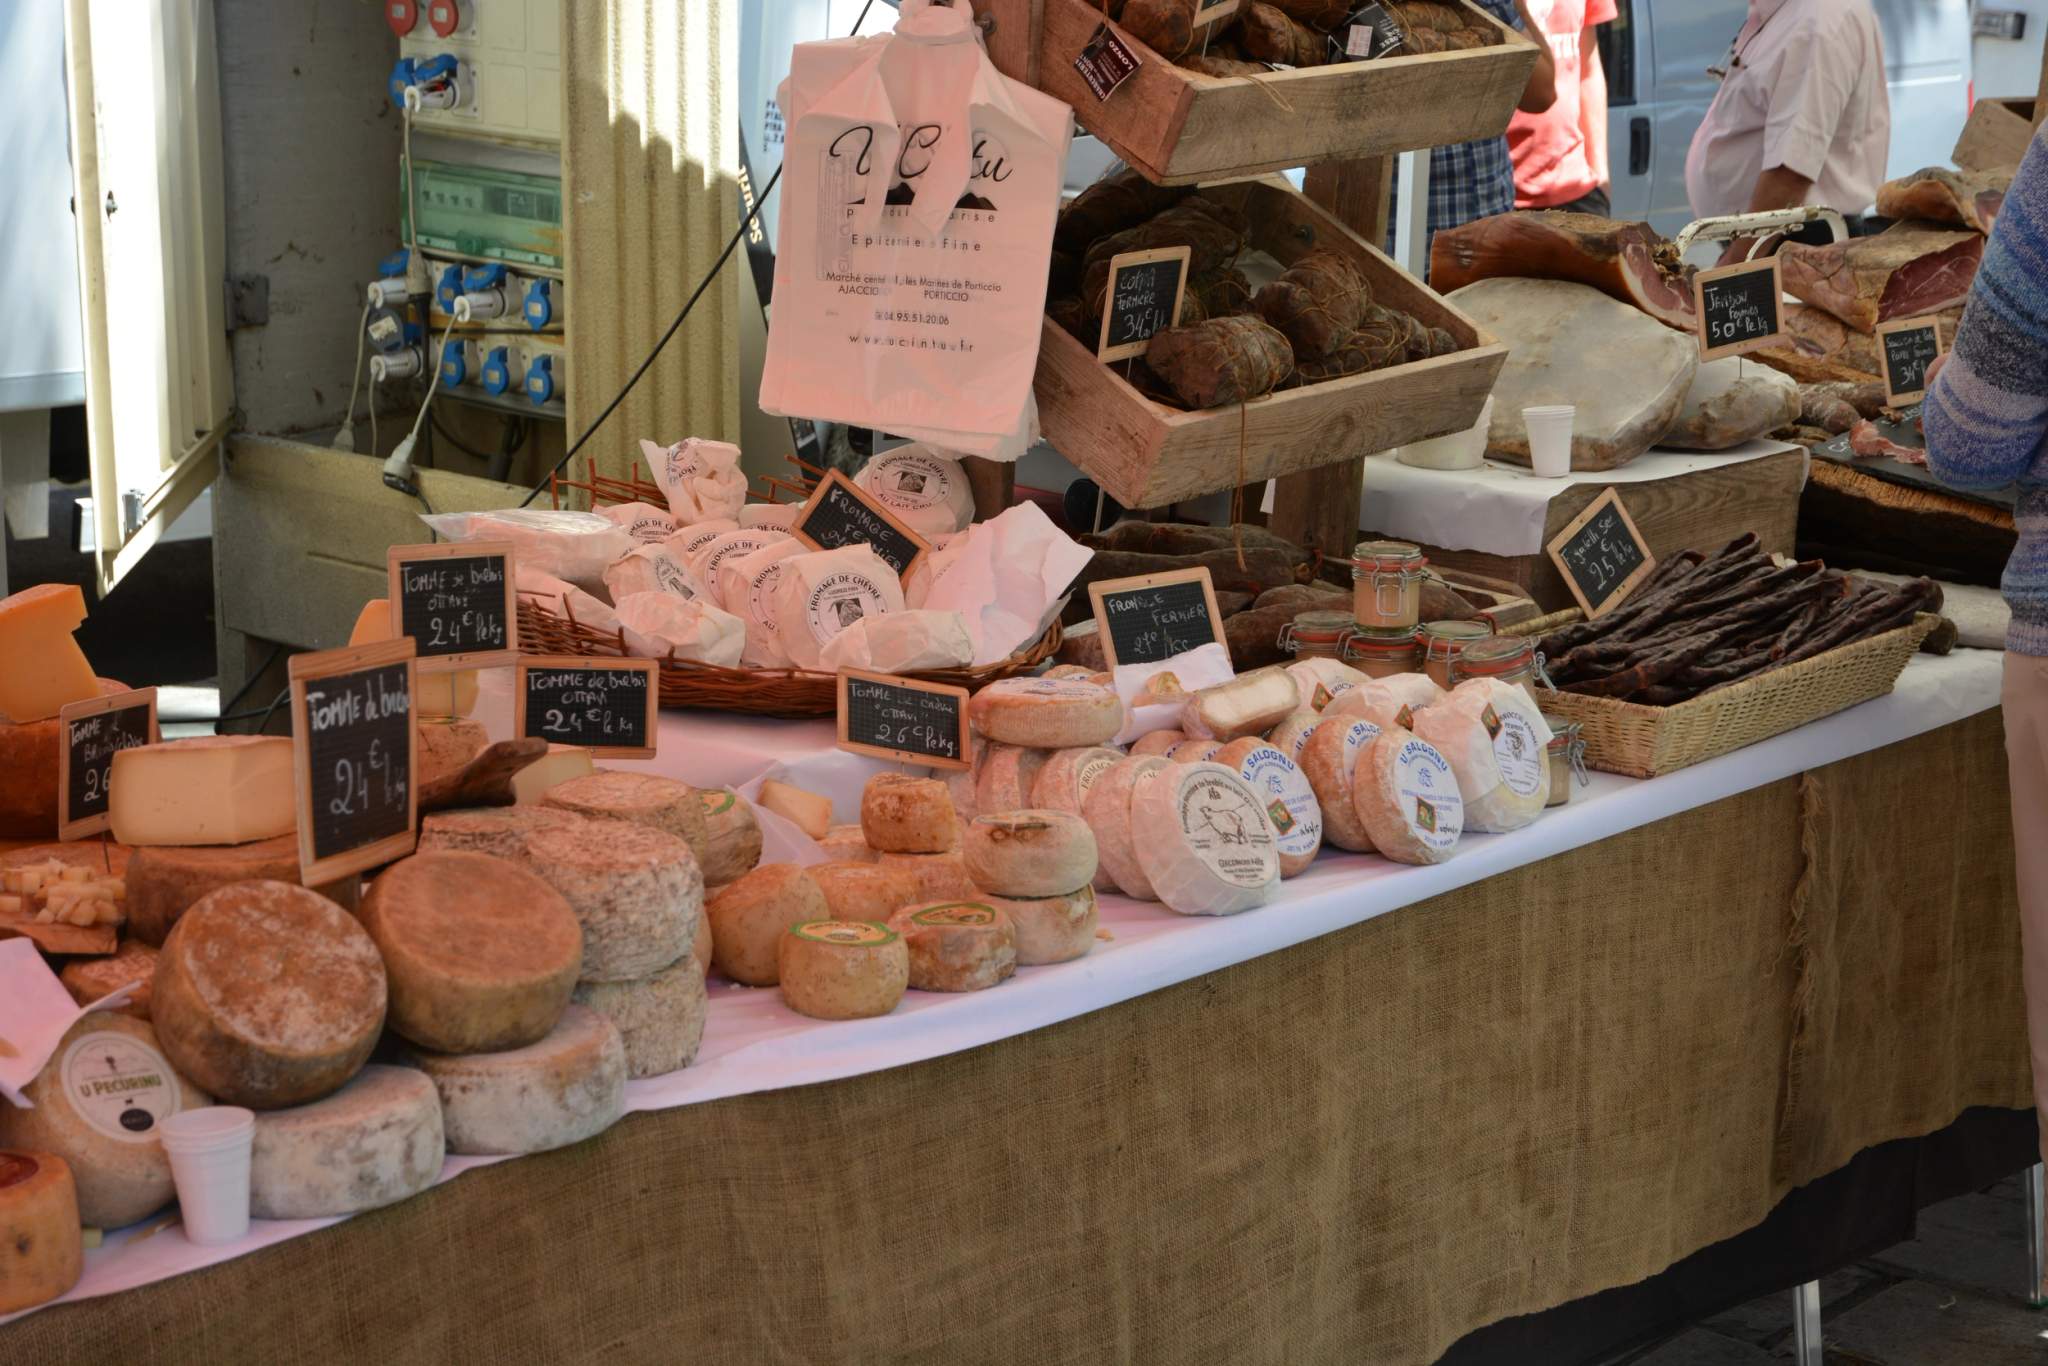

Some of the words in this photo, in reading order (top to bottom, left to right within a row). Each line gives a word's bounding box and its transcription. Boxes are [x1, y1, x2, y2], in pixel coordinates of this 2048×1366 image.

[1108, 40, 1134, 71] LONZO
[943, 238, 981, 251] Fine
[826, 272, 861, 283] Marché
[952, 279, 962, 290] de
[964, 280, 1002, 292] Porticcio
[838, 285, 879, 296] AJACCIO
[923, 289, 969, 302] PORTICCIO
[878, 456, 912, 471] FROMAGE
[829, 488, 894, 542] FROMAGE
[709, 542, 740, 571] FROMAGE
[810, 577, 837, 611] FROMAGE
[838, 574, 850, 583] DE
[588, 671, 605, 689] de
[1347, 735, 1356, 745] U
[1247, 749, 1295, 771] SALOGNU
[1401, 753, 1409, 765] U
[1406, 741, 1448, 772] SALOGNU
[1243, 771, 1252, 781] U
[80, 1084, 92, 1098] U
